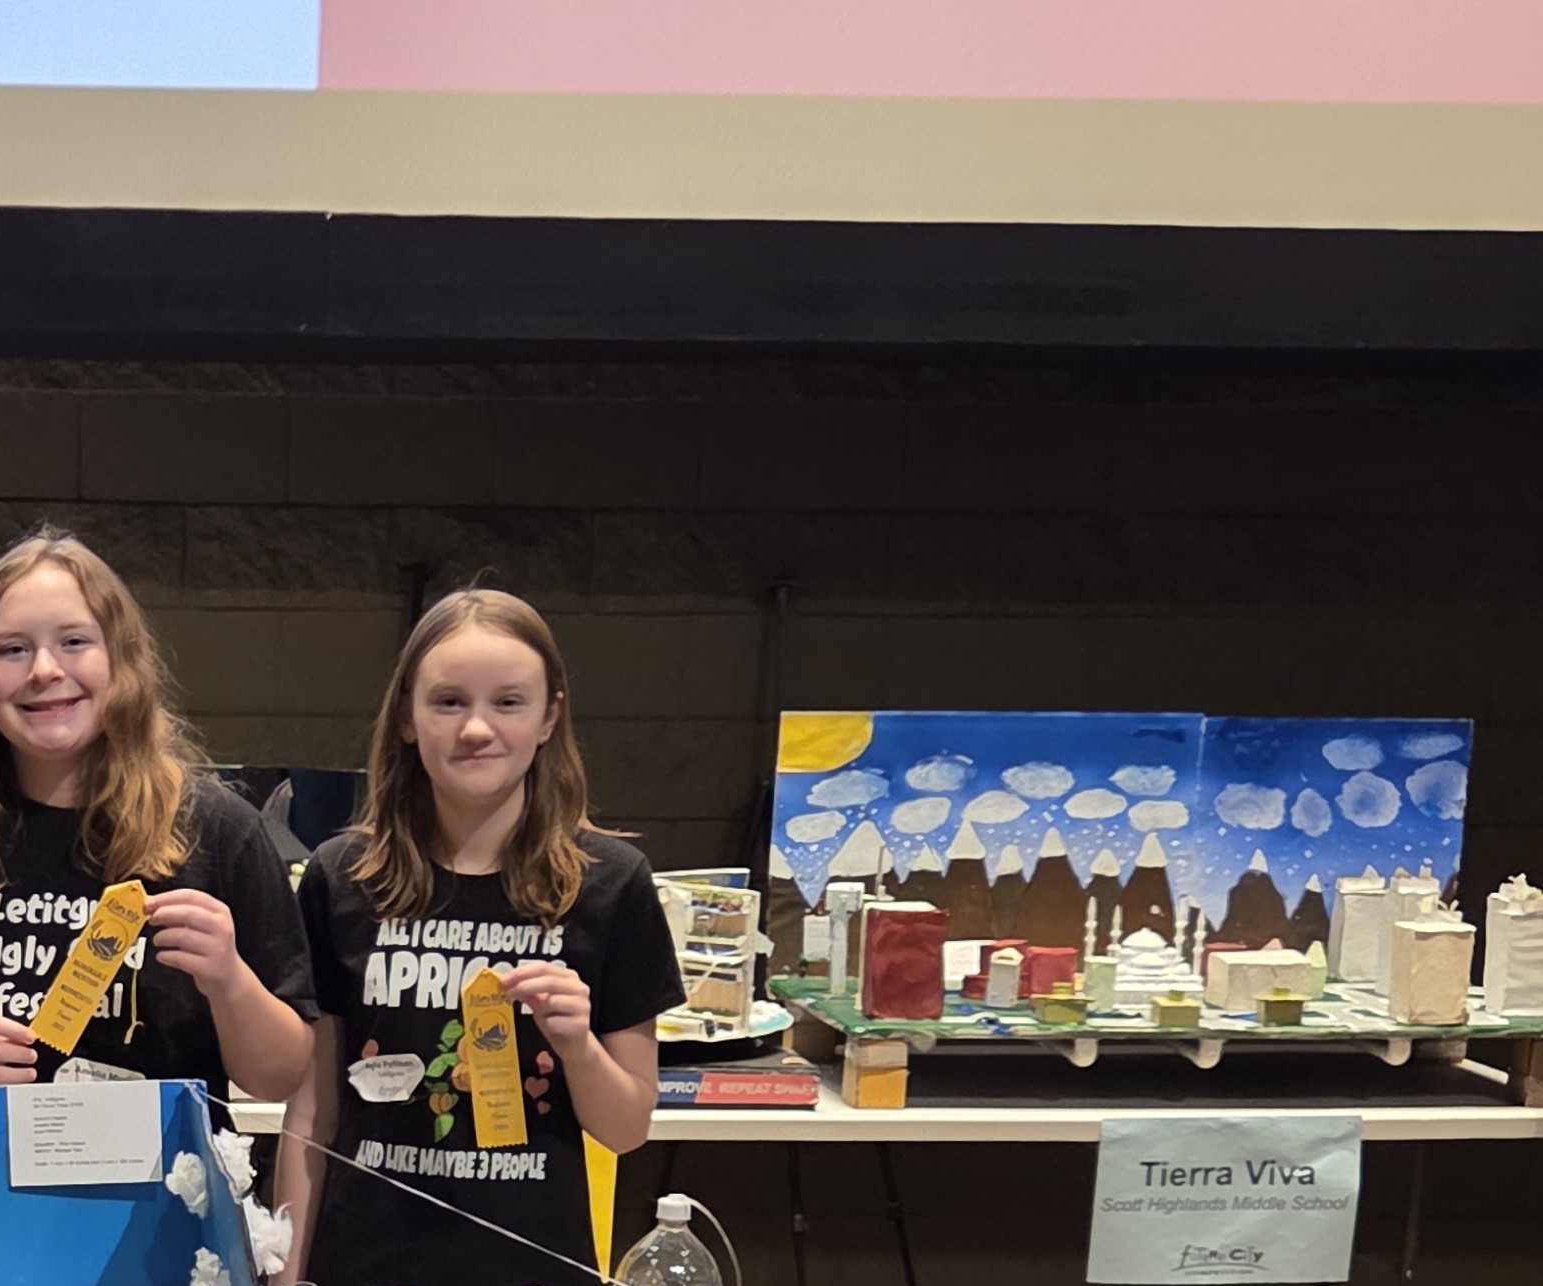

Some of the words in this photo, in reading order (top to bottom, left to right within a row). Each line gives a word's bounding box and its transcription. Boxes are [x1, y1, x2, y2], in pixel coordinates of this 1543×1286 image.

[376, 918, 409, 947] ALL
[411, 920, 421, 947] I
[423, 919, 474, 951] CARE
[474, 922, 541, 955] ABOUT
[542, 925, 564, 956] IS
[657, 1080, 712, 1094] MPROVE
[355, 1139, 384, 1168] AND
[385, 1143, 418, 1173] LIKE
[419, 1147, 477, 1178] MAYBE
[477, 1150, 490, 1180] 3
[490, 1152, 548, 1180] PEOPLE
[1140, 1161, 1232, 1187] Tierra
[1246, 1159, 1316, 1187] Viva
[1101, 1196, 1143, 1212] Scott
[1147, 1196, 1227, 1215] Highlands
[1232, 1196, 1286, 1211] Middle
[1292, 1195, 1349, 1212] School
